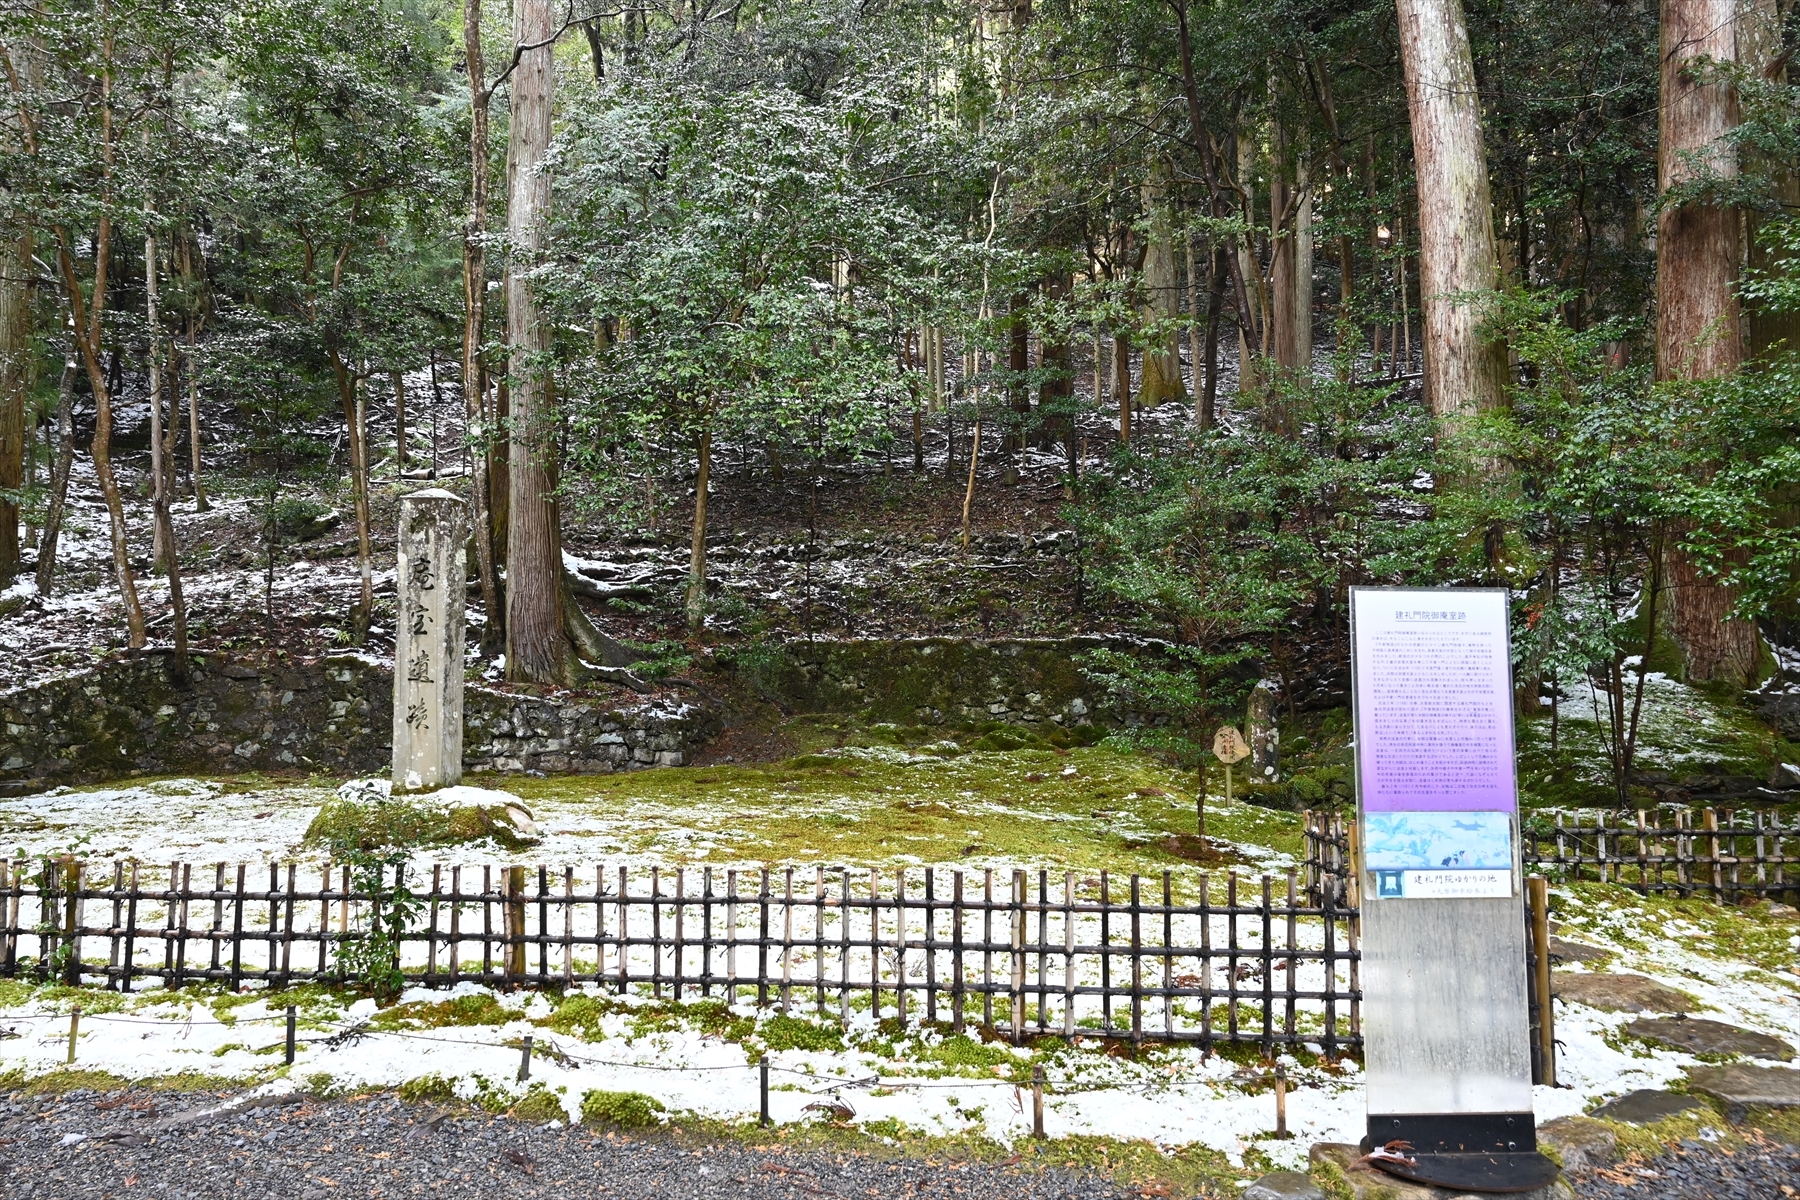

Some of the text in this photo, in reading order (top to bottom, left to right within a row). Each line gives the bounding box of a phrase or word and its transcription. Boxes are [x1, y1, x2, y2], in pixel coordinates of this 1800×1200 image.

[1395, 611, 1467, 620] 建礼門院御庵室跡
[1414, 874, 1497, 885] 建礼門院ゆかりの地
